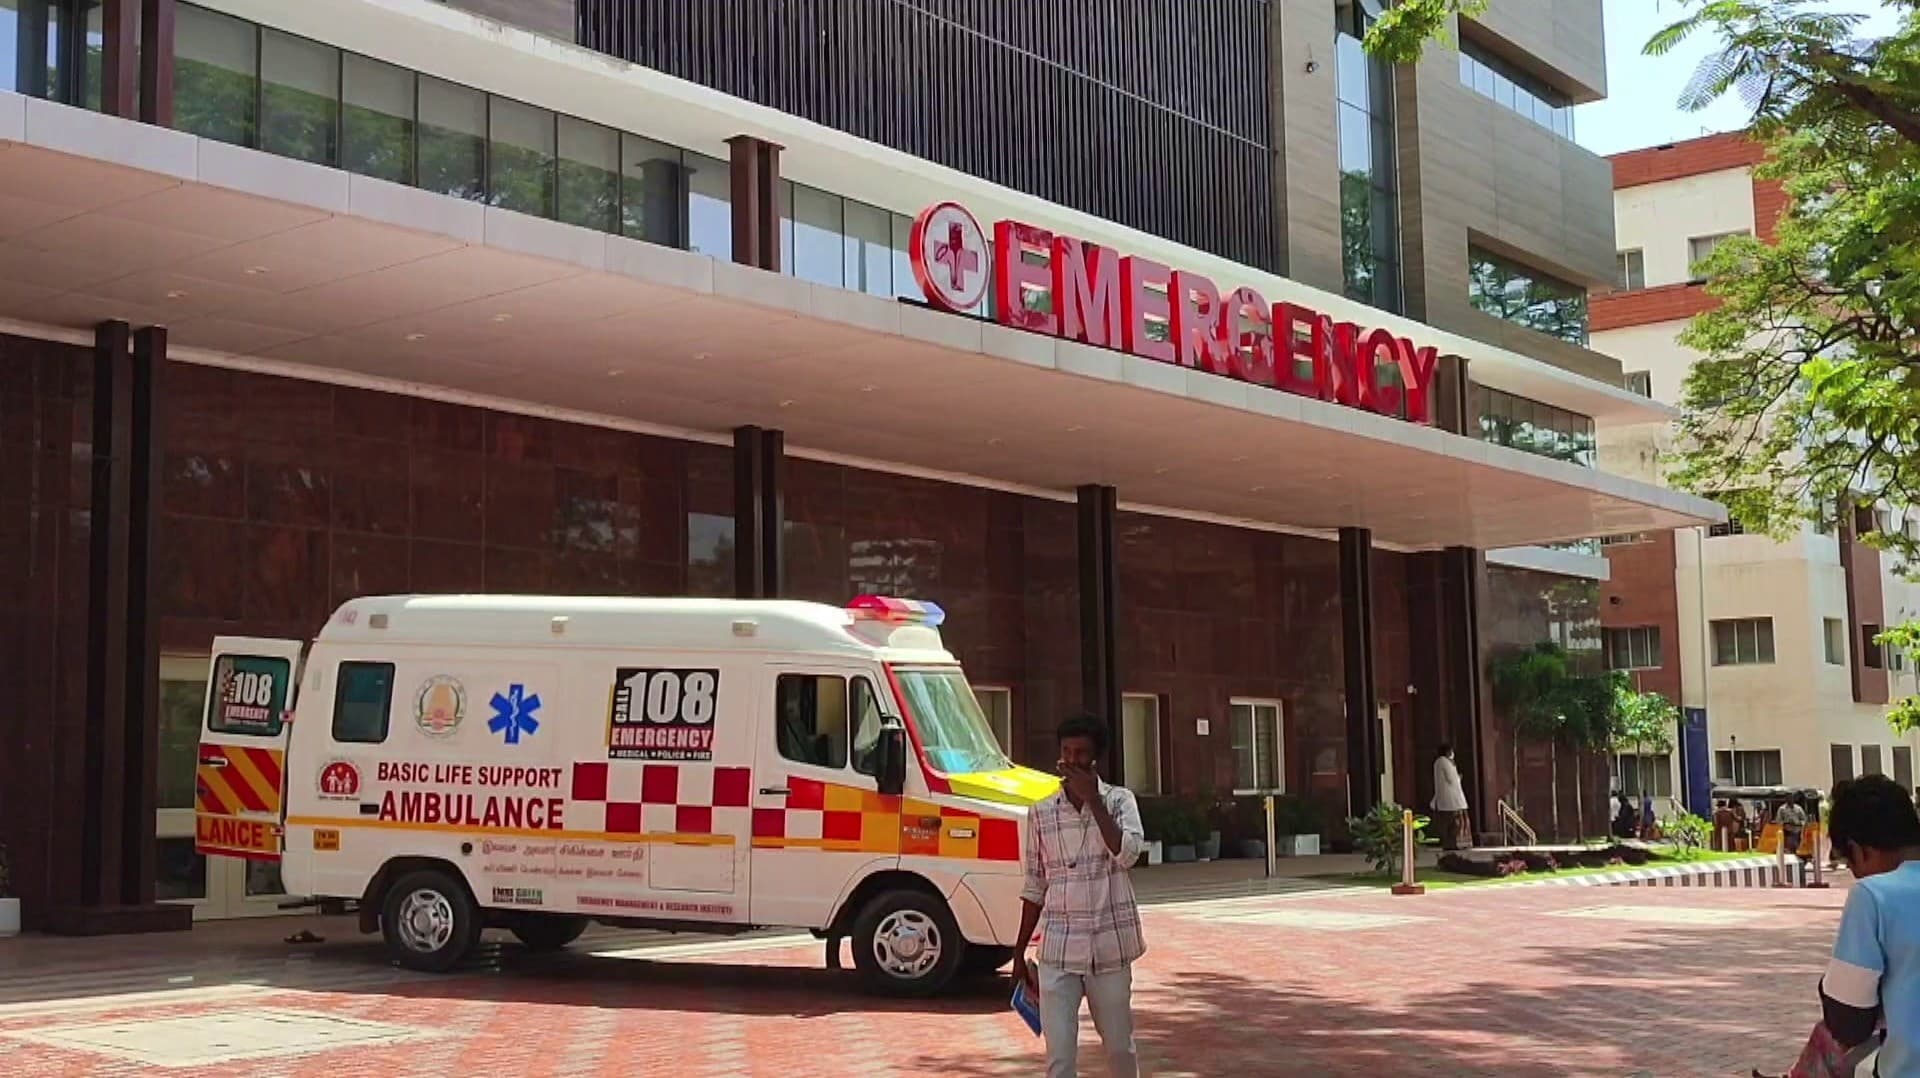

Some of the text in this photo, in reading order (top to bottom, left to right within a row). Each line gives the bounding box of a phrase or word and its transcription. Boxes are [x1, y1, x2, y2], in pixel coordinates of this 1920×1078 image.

[994, 218, 1438, 424] EMERGENCY
[233, 671, 273, 706] 108
[615, 688, 629, 722] CALL
[623, 671, 715, 723] 108
[611, 727, 712, 748] EMERGENCY
[378, 762, 429, 782] BASIC
[435, 764, 473, 785] LIFE
[478, 766, 562, 788] SUPPORT
[379, 790, 564, 829] AMBULANCE
[197, 815, 264, 847] LANCE
